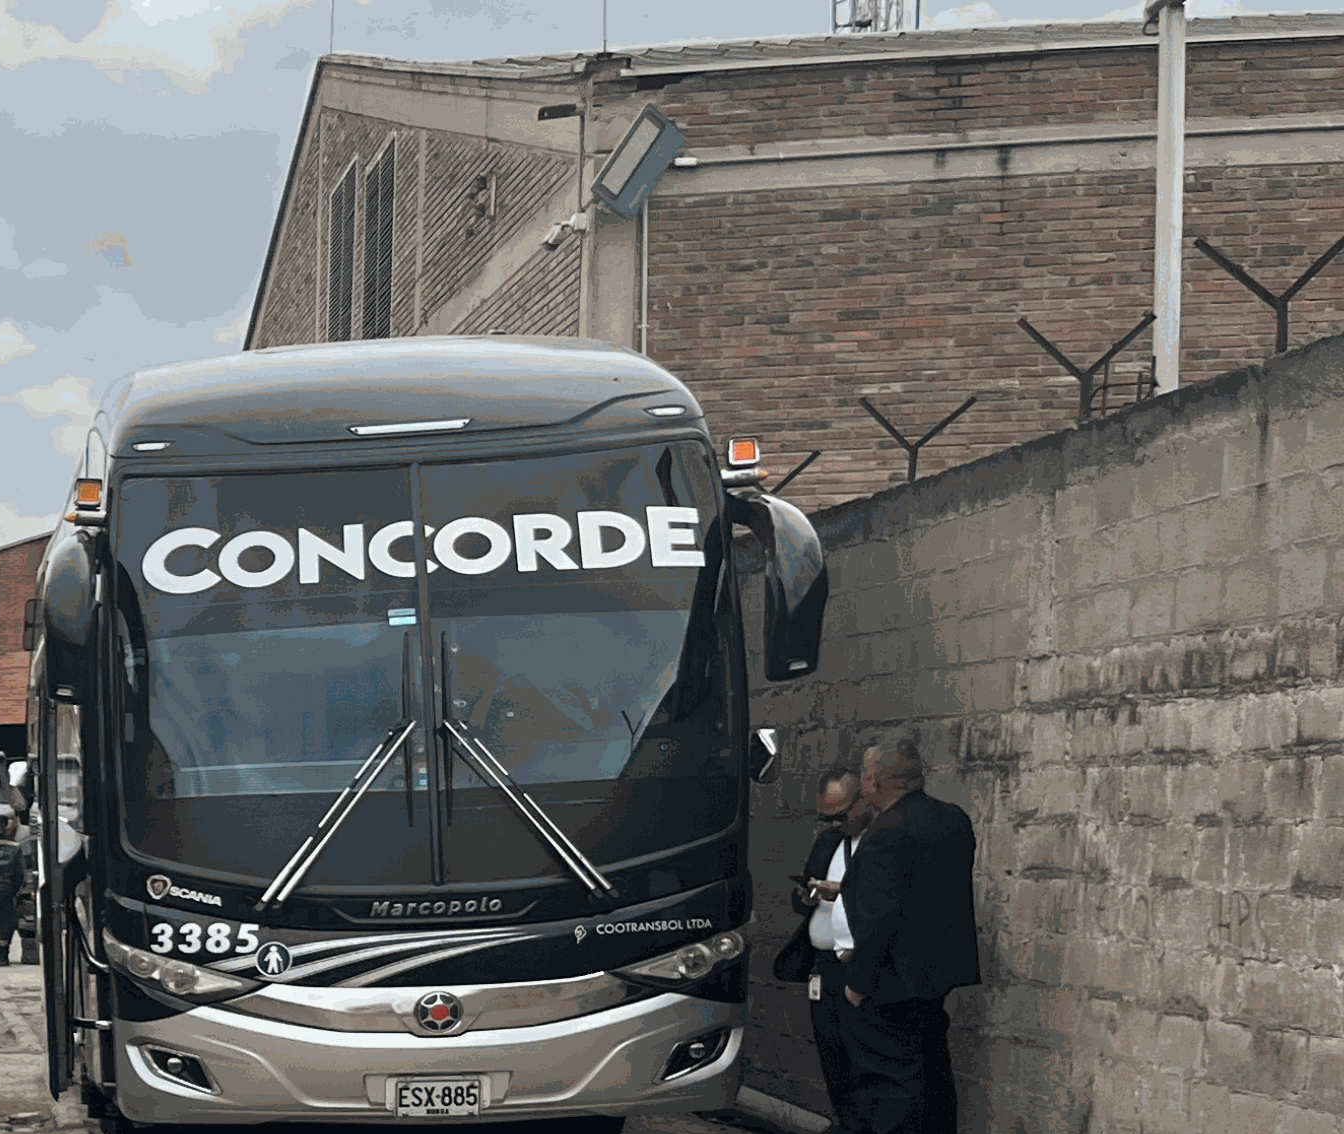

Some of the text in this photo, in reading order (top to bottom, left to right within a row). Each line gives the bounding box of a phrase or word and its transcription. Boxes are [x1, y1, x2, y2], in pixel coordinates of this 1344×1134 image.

[141, 505, 706, 595] CONCORDE
[169, 886, 223, 907] SCANIA
[369, 896, 503, 917] Marcopolo
[595, 918, 713, 935] COOTRANSBOL LTDA
[150, 922, 260, 954] 3385
